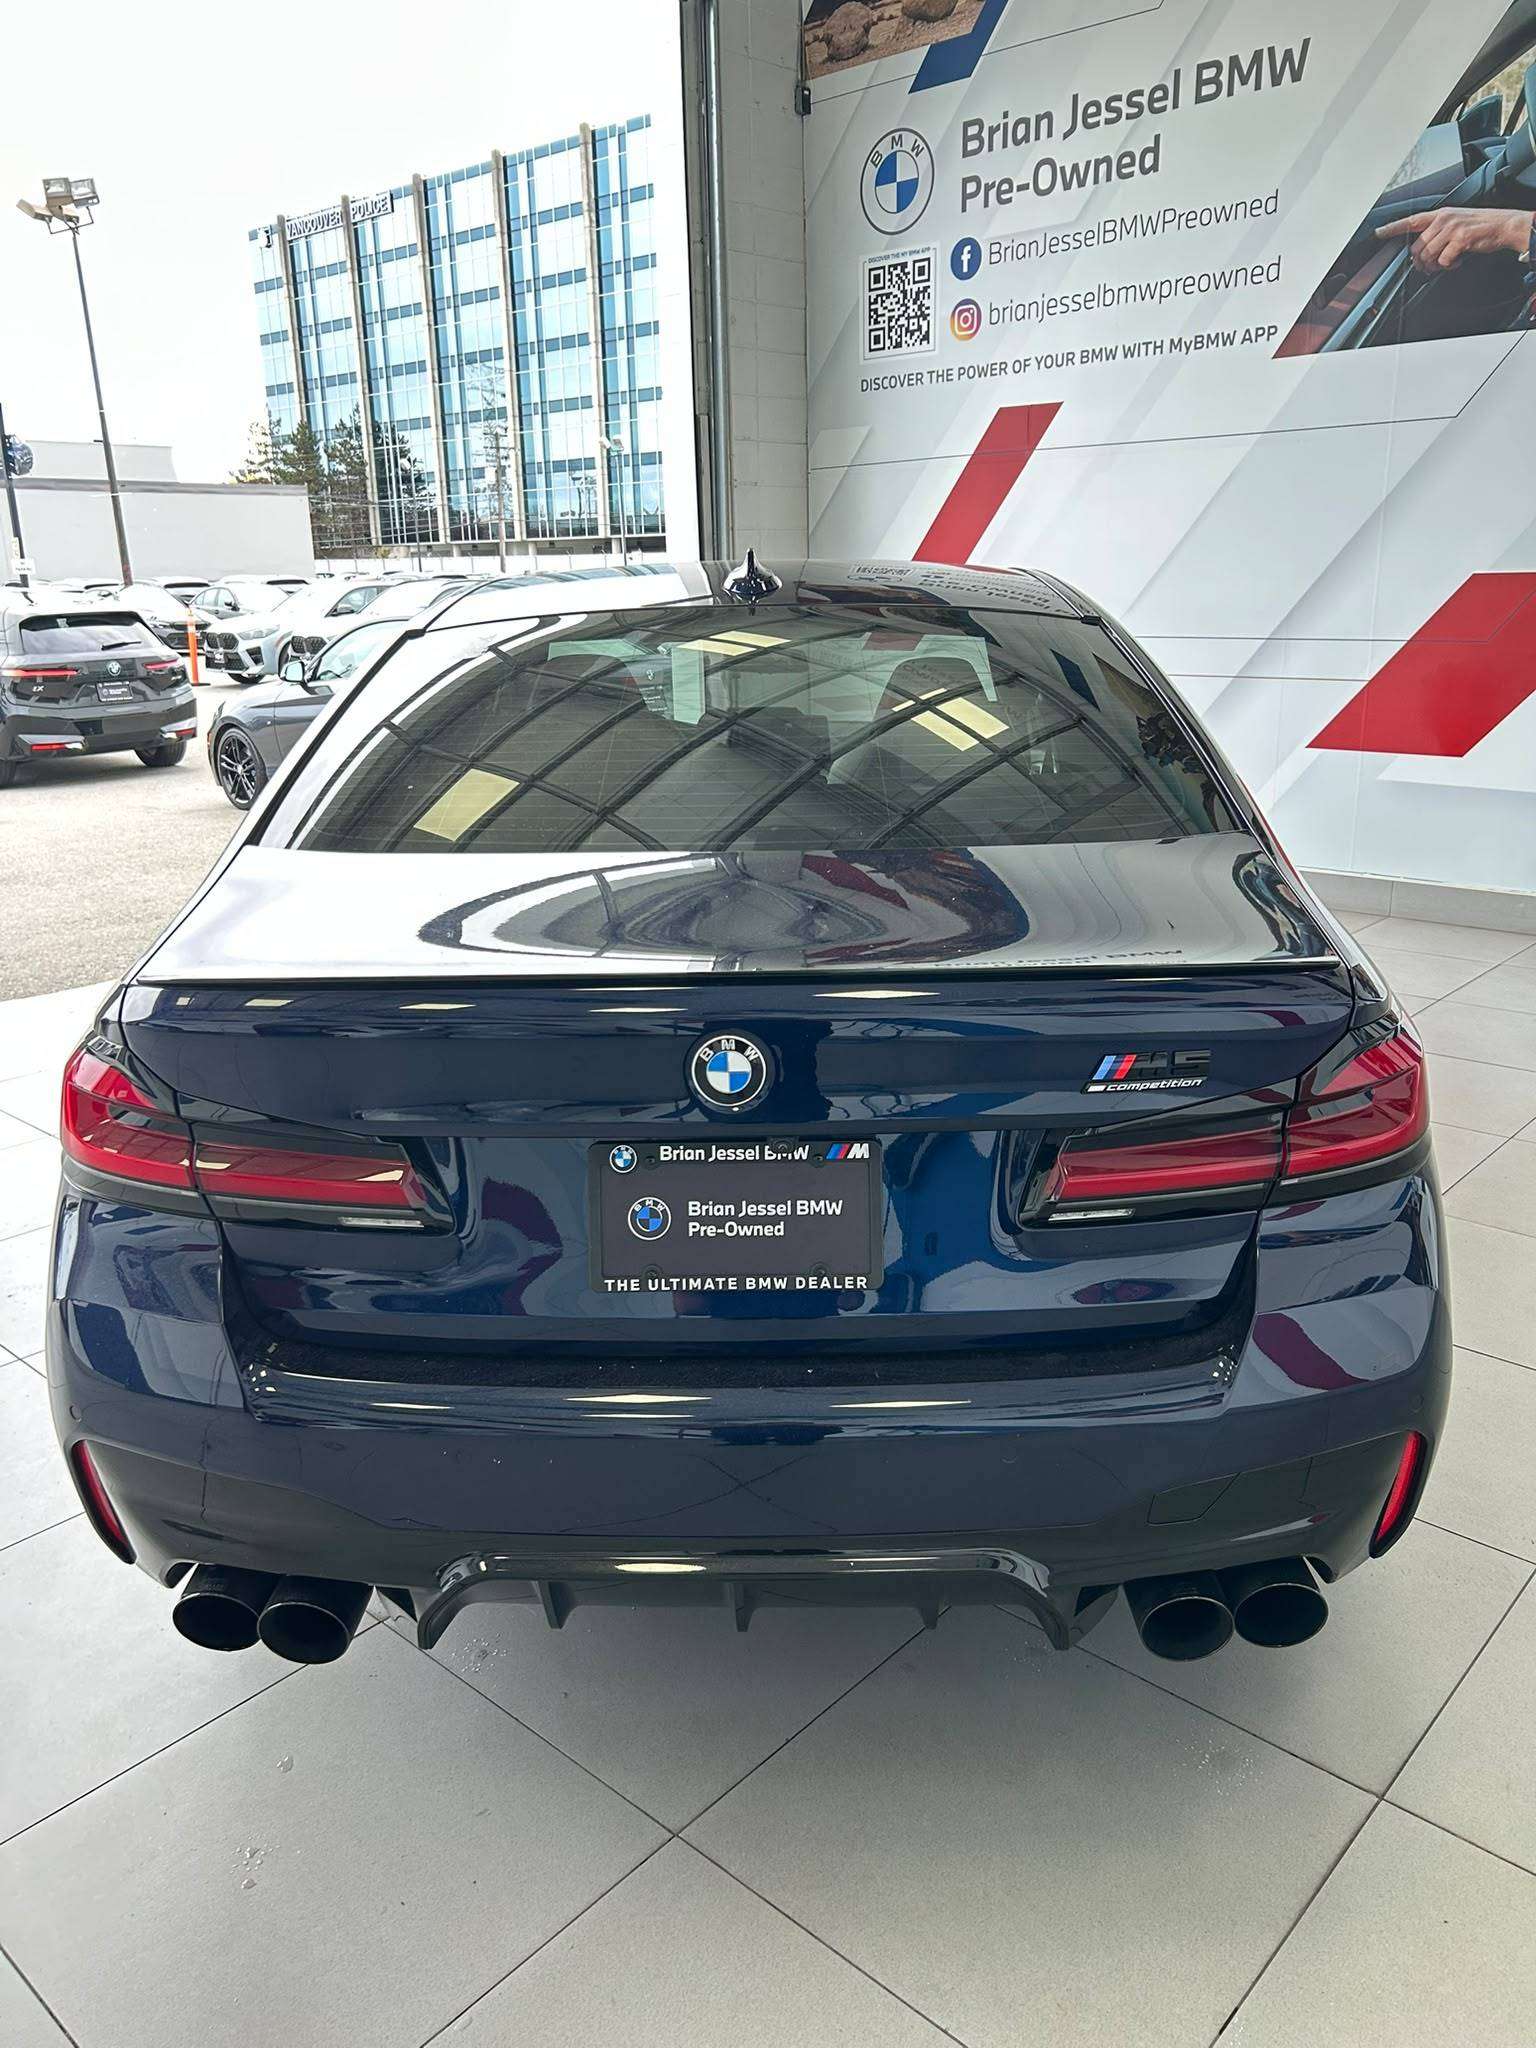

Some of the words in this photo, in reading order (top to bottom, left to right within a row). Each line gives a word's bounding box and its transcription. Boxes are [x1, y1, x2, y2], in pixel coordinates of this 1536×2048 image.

[961, 109, 1054, 159] Brian
[1062, 67, 1182, 141] Jessel
[1194, 36, 1312, 105] BMW
[870, 133, 925, 169] BMW
[960, 133, 1162, 214] Pre-Owned
[351, 196, 389, 220] POLICE
[988, 189, 1279, 265] BrianJesselBMWPreowned
[988, 255, 1281, 326] brianjesselbmwpreowned
[861, 372, 925, 393] DISCOVER
[927, 368, 955, 385] THE
[957, 361, 1009, 381] POWER
[1012, 357, 1032, 374] OF
[1034, 351, 1076, 371] YOUR
[1079, 345, 1119, 365] BMW
[1122, 340, 1165, 360] WITH
[1169, 330, 1237, 356] MyBMW
[1240, 325, 1279, 345] APP
[699, 1039, 760, 1062] BMW
[1105, 1077, 1203, 1092] competition
[660, 1145, 705, 1161] Brian
[708, 1144, 760, 1162] Jessel
[633, 1199, 667, 1212] BMW
[687, 1200, 735, 1217] Brian
[738, 1199, 792, 1218] Jessel
[796, 1199, 843, 1216] BMW
[687, 1221, 785, 1237] Pre-Owned
[604, 1279, 640, 1292] THE
[647, 1277, 738, 1291] ULTIMATE
[745, 1277, 788, 1290] BMW
[795, 1276, 868, 1289] DEALER
